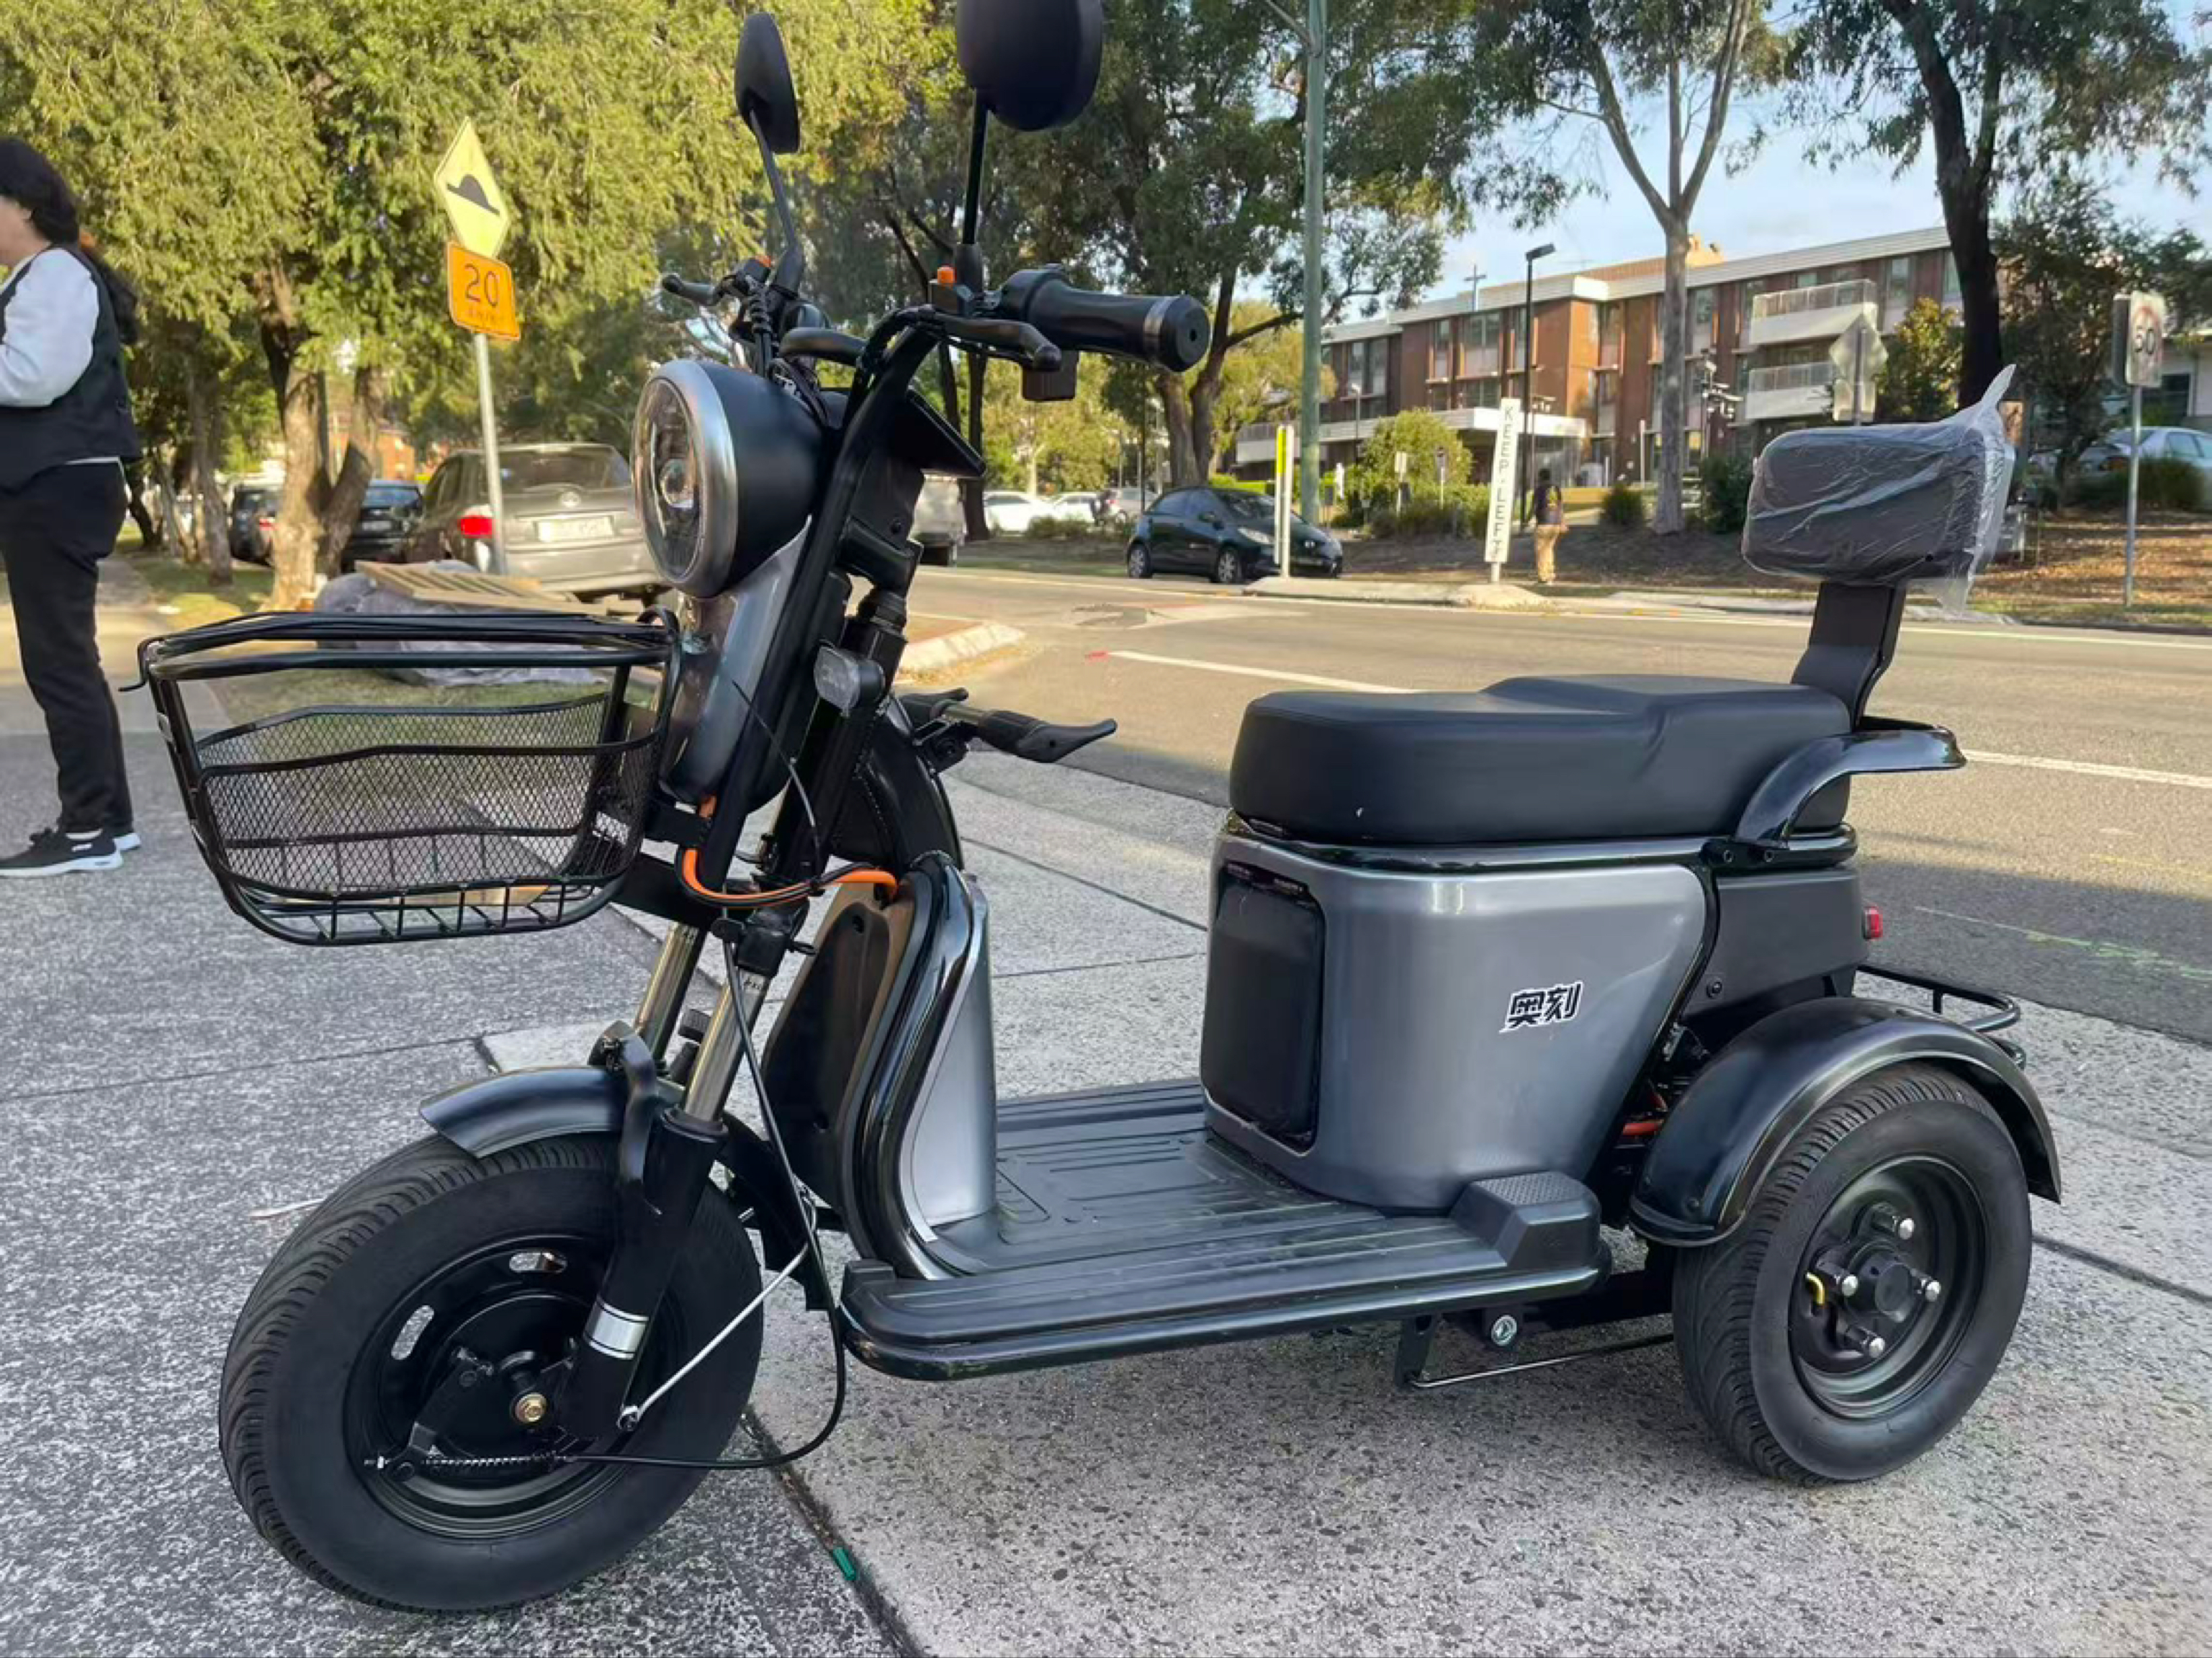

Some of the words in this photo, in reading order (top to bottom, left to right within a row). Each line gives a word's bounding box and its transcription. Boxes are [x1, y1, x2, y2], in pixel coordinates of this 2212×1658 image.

[464, 263, 499, 308] 20
[1498, 406, 1514, 474] KEEP
[1491, 487, 1506, 556] LEFT
[1506, 982, 1583, 1029] 奥刻
